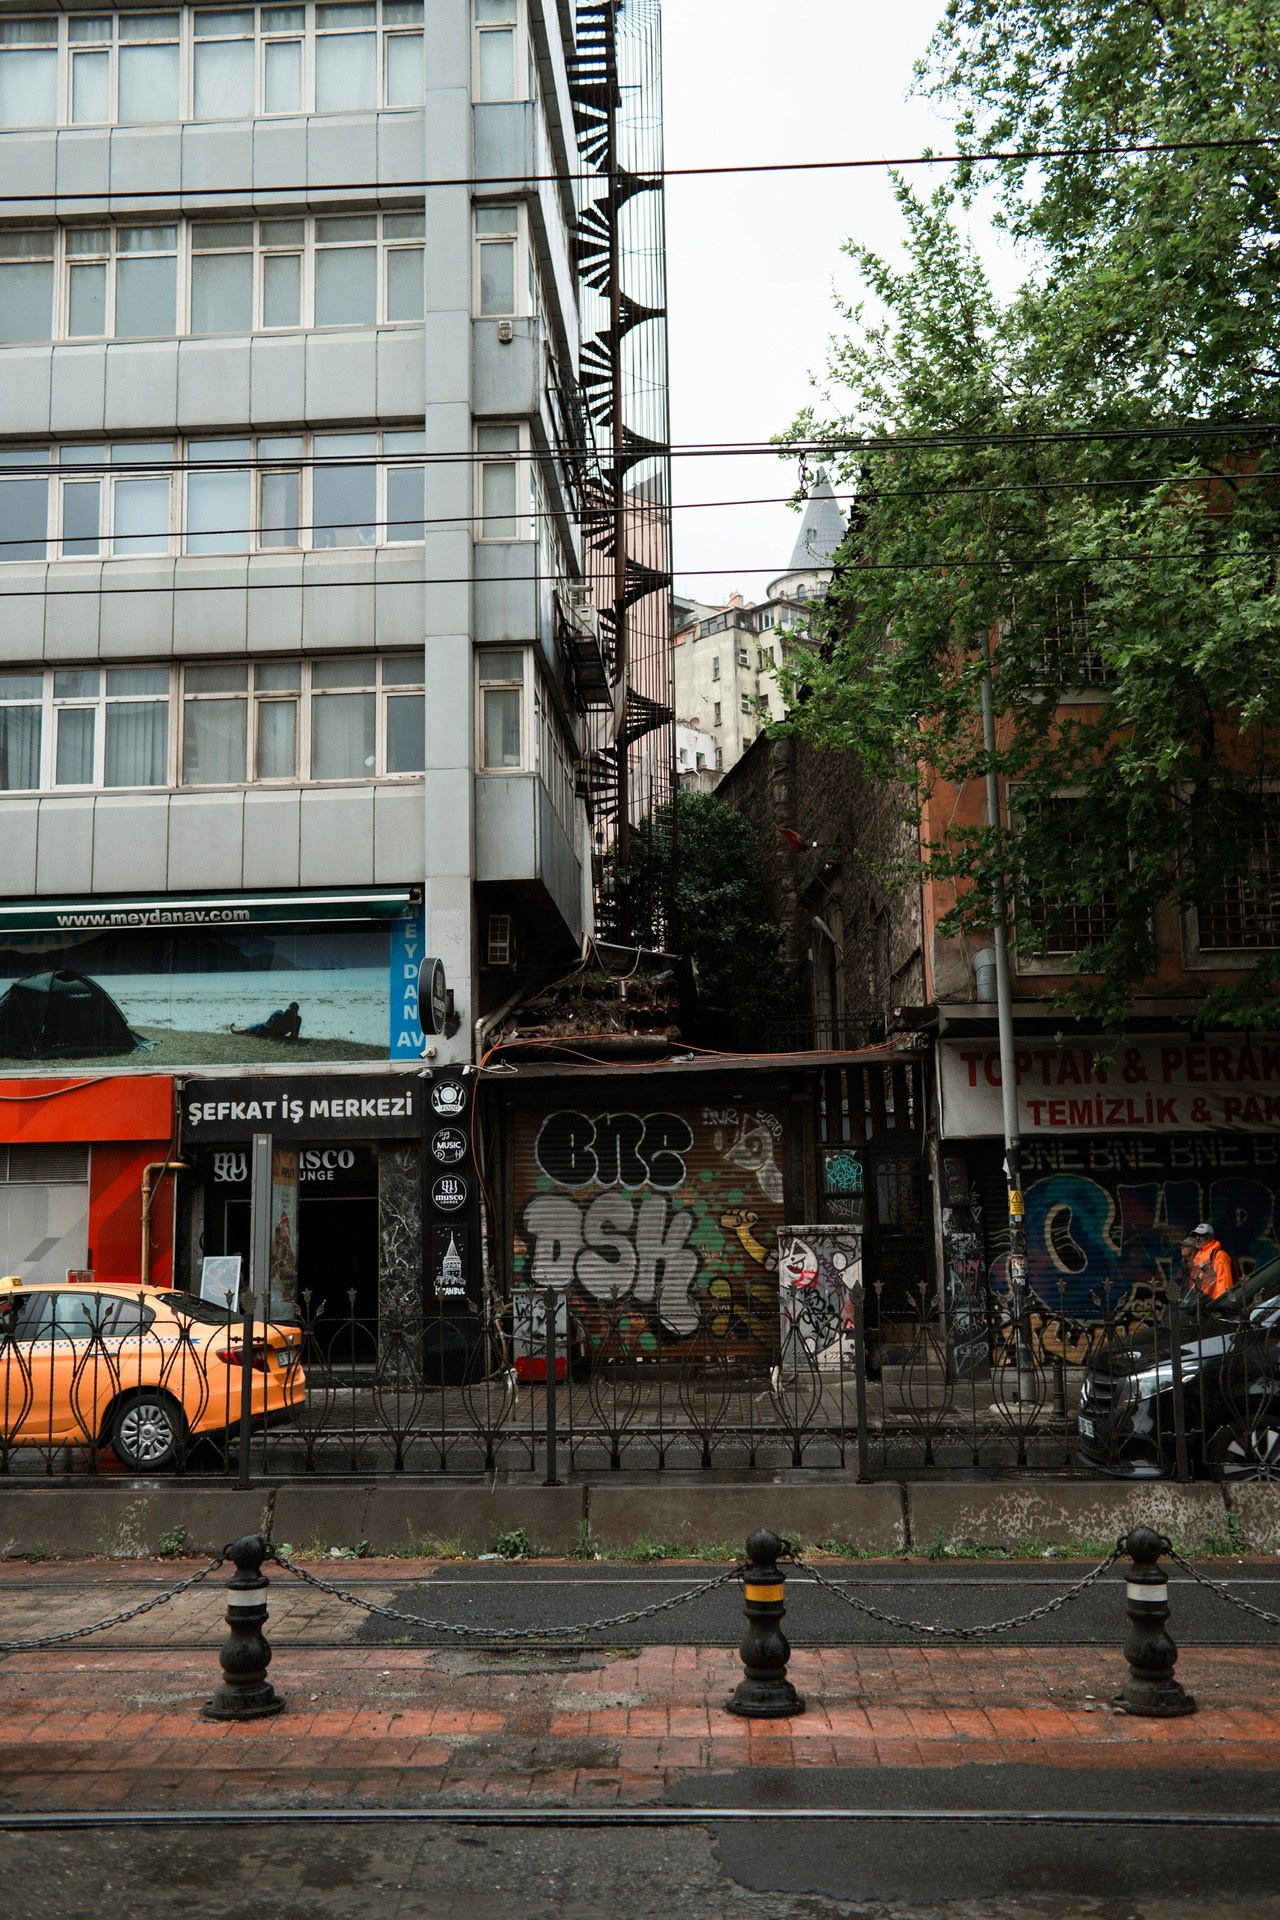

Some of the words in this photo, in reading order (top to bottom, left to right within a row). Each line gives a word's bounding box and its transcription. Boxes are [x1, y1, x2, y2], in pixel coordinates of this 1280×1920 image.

[56, 908, 250, 927] www.meydanav.com
[396, 1031, 425, 1048] AV
[960, 1048, 1108, 1087] TOPTAN
[1123, 1047, 1149, 1084] &
[1161, 1046, 1280, 1083] PERAK
[188, 1101, 277, 1126] ŞEFKAT
[282, 1094, 304, 1123] İŞ
[310, 1091, 412, 1118] MERKEZİ
[1027, 1092, 1179, 1126] TEMİZLİK
[1191, 1096, 1212, 1123] &
[436, 1141, 462, 1149] MUSIC
[1088, 1138, 1166, 1172] BNE
[1170, 1137, 1249, 1170] BNE
[300, 1150, 355, 1169] sco
[300, 1170, 334, 1181] UNGE
